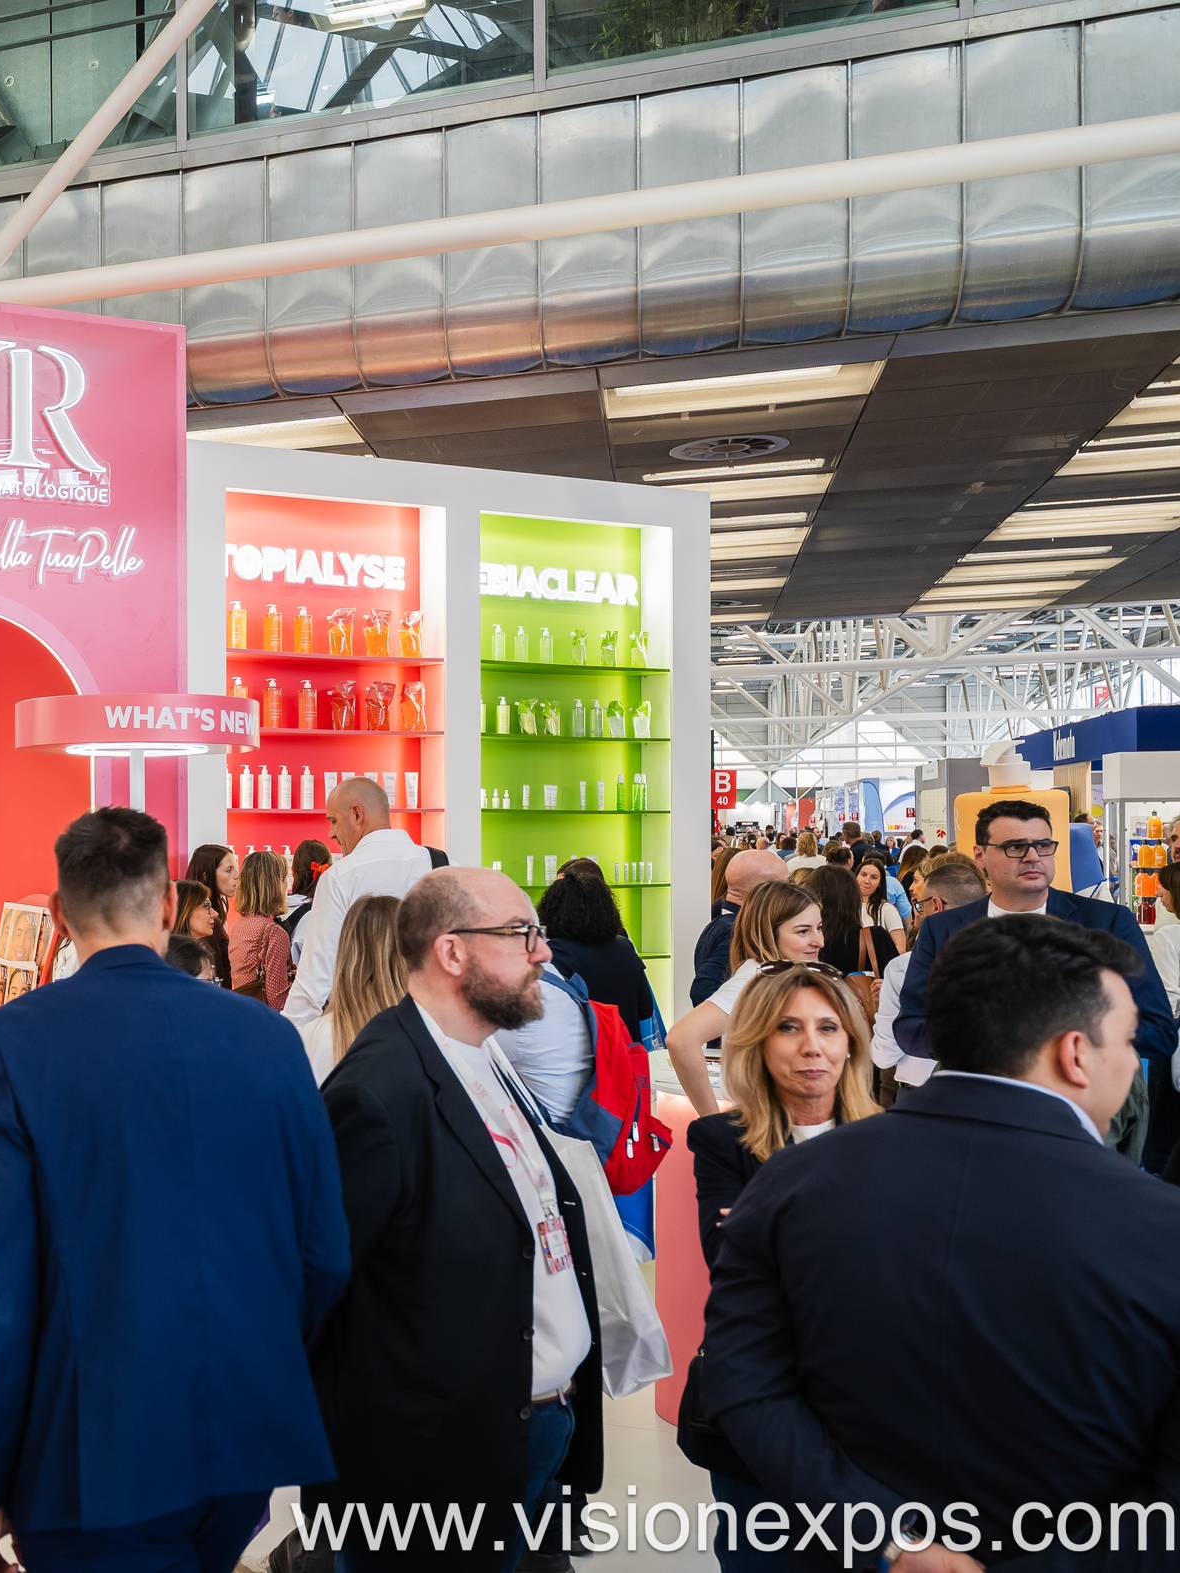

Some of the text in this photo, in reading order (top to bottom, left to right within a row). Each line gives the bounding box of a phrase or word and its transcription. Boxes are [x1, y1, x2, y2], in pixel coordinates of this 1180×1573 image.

[104, 704, 255, 736] WHAT'S NEW
[715, 771, 732, 793] B
[716, 796, 729, 806] 40
